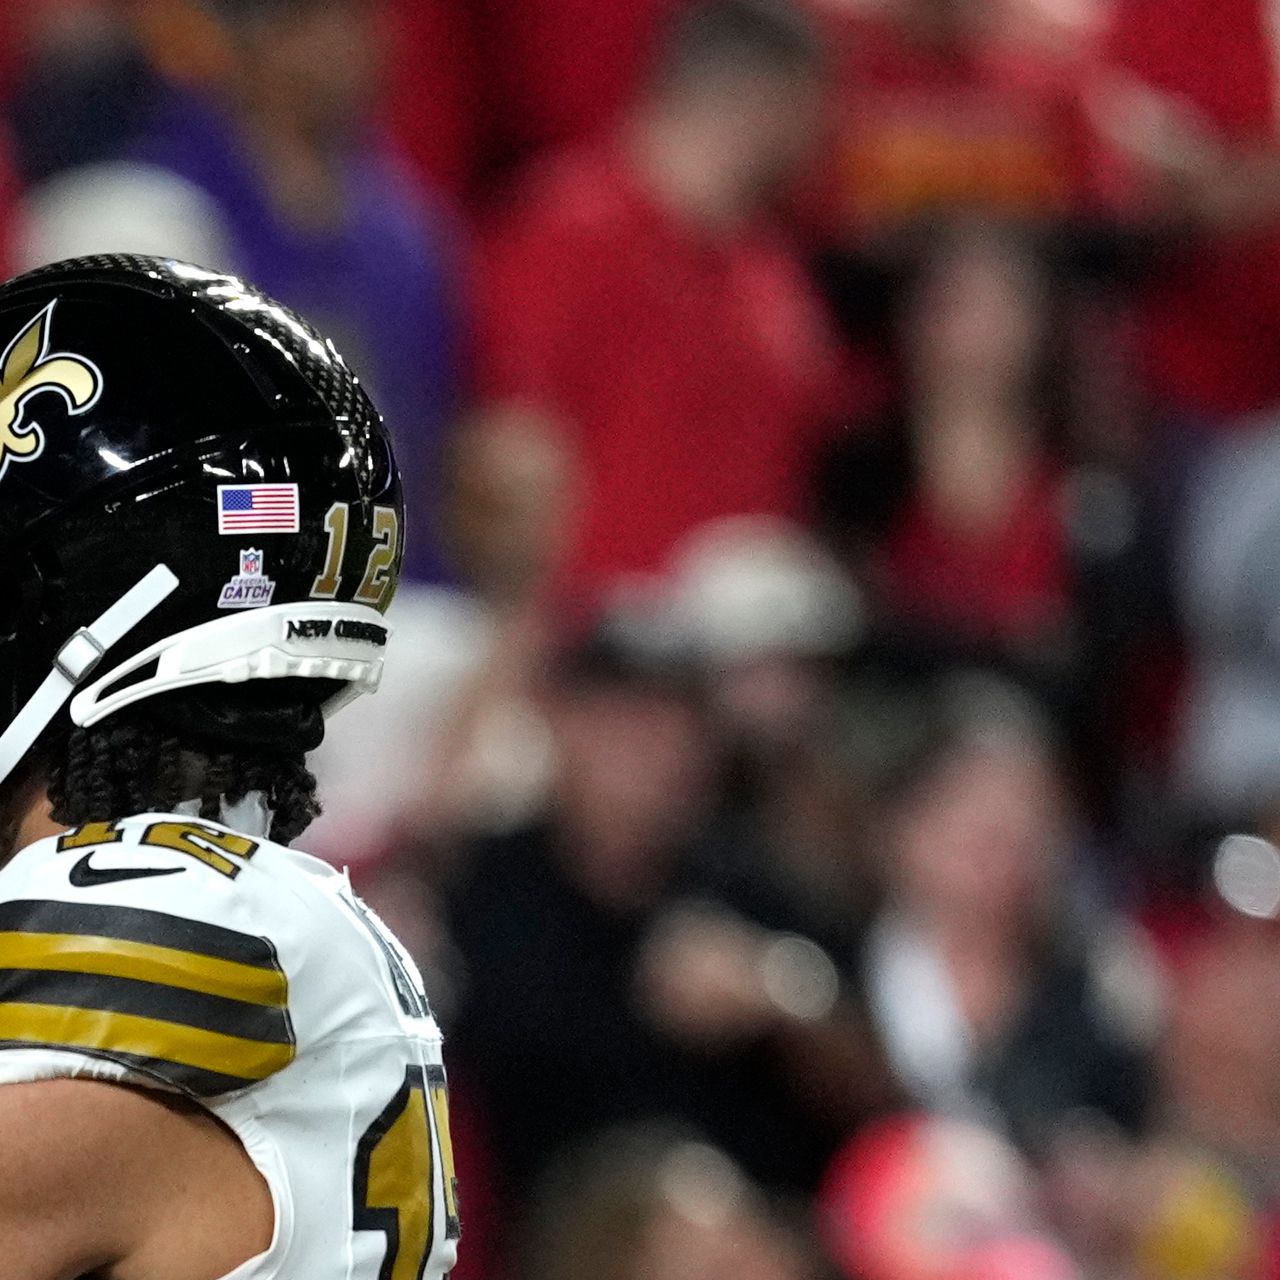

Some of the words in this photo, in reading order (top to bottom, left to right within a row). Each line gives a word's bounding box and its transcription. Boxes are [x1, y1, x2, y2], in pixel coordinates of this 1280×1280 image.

[309, 502, 398, 603] 12
[223, 585, 272, 600] CATCH
[286, 620, 333, 640] NEW
[56, 821, 260, 881] 12
